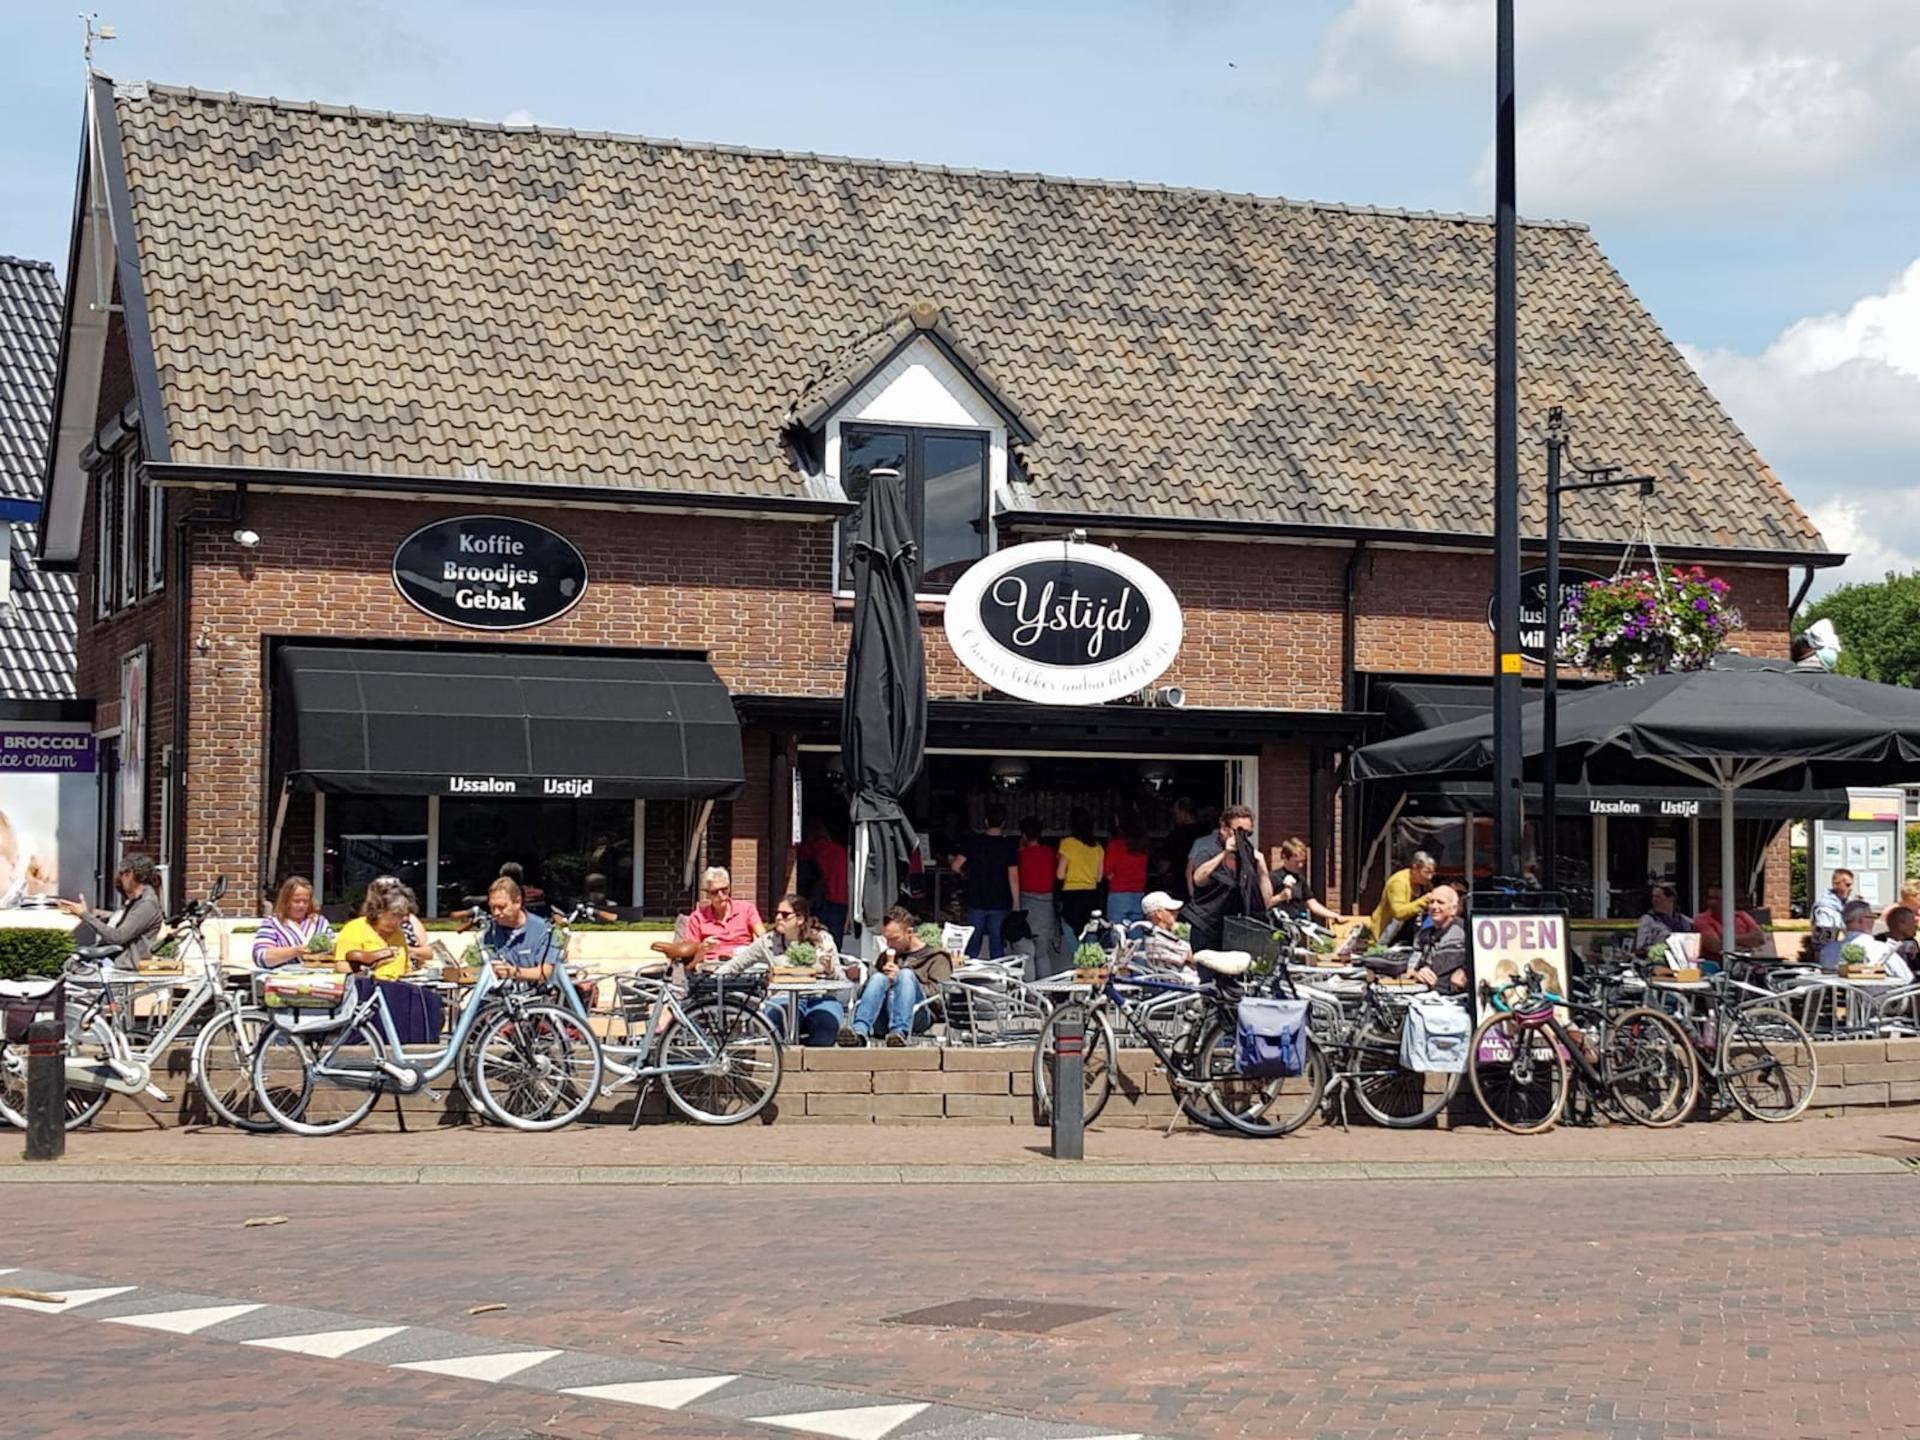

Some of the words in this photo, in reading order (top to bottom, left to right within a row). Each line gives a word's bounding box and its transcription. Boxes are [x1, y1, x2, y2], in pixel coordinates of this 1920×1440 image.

[460, 534, 524, 556] Koffie
[443, 561, 538, 587] Broodjes
[455, 589, 526, 612] Gebak
[993, 576, 1131, 657] Ystijd
[4, 736, 88, 749] BROCCOLI
[25, 754, 78, 768] cream
[1477, 920, 1557, 950] OPEN
